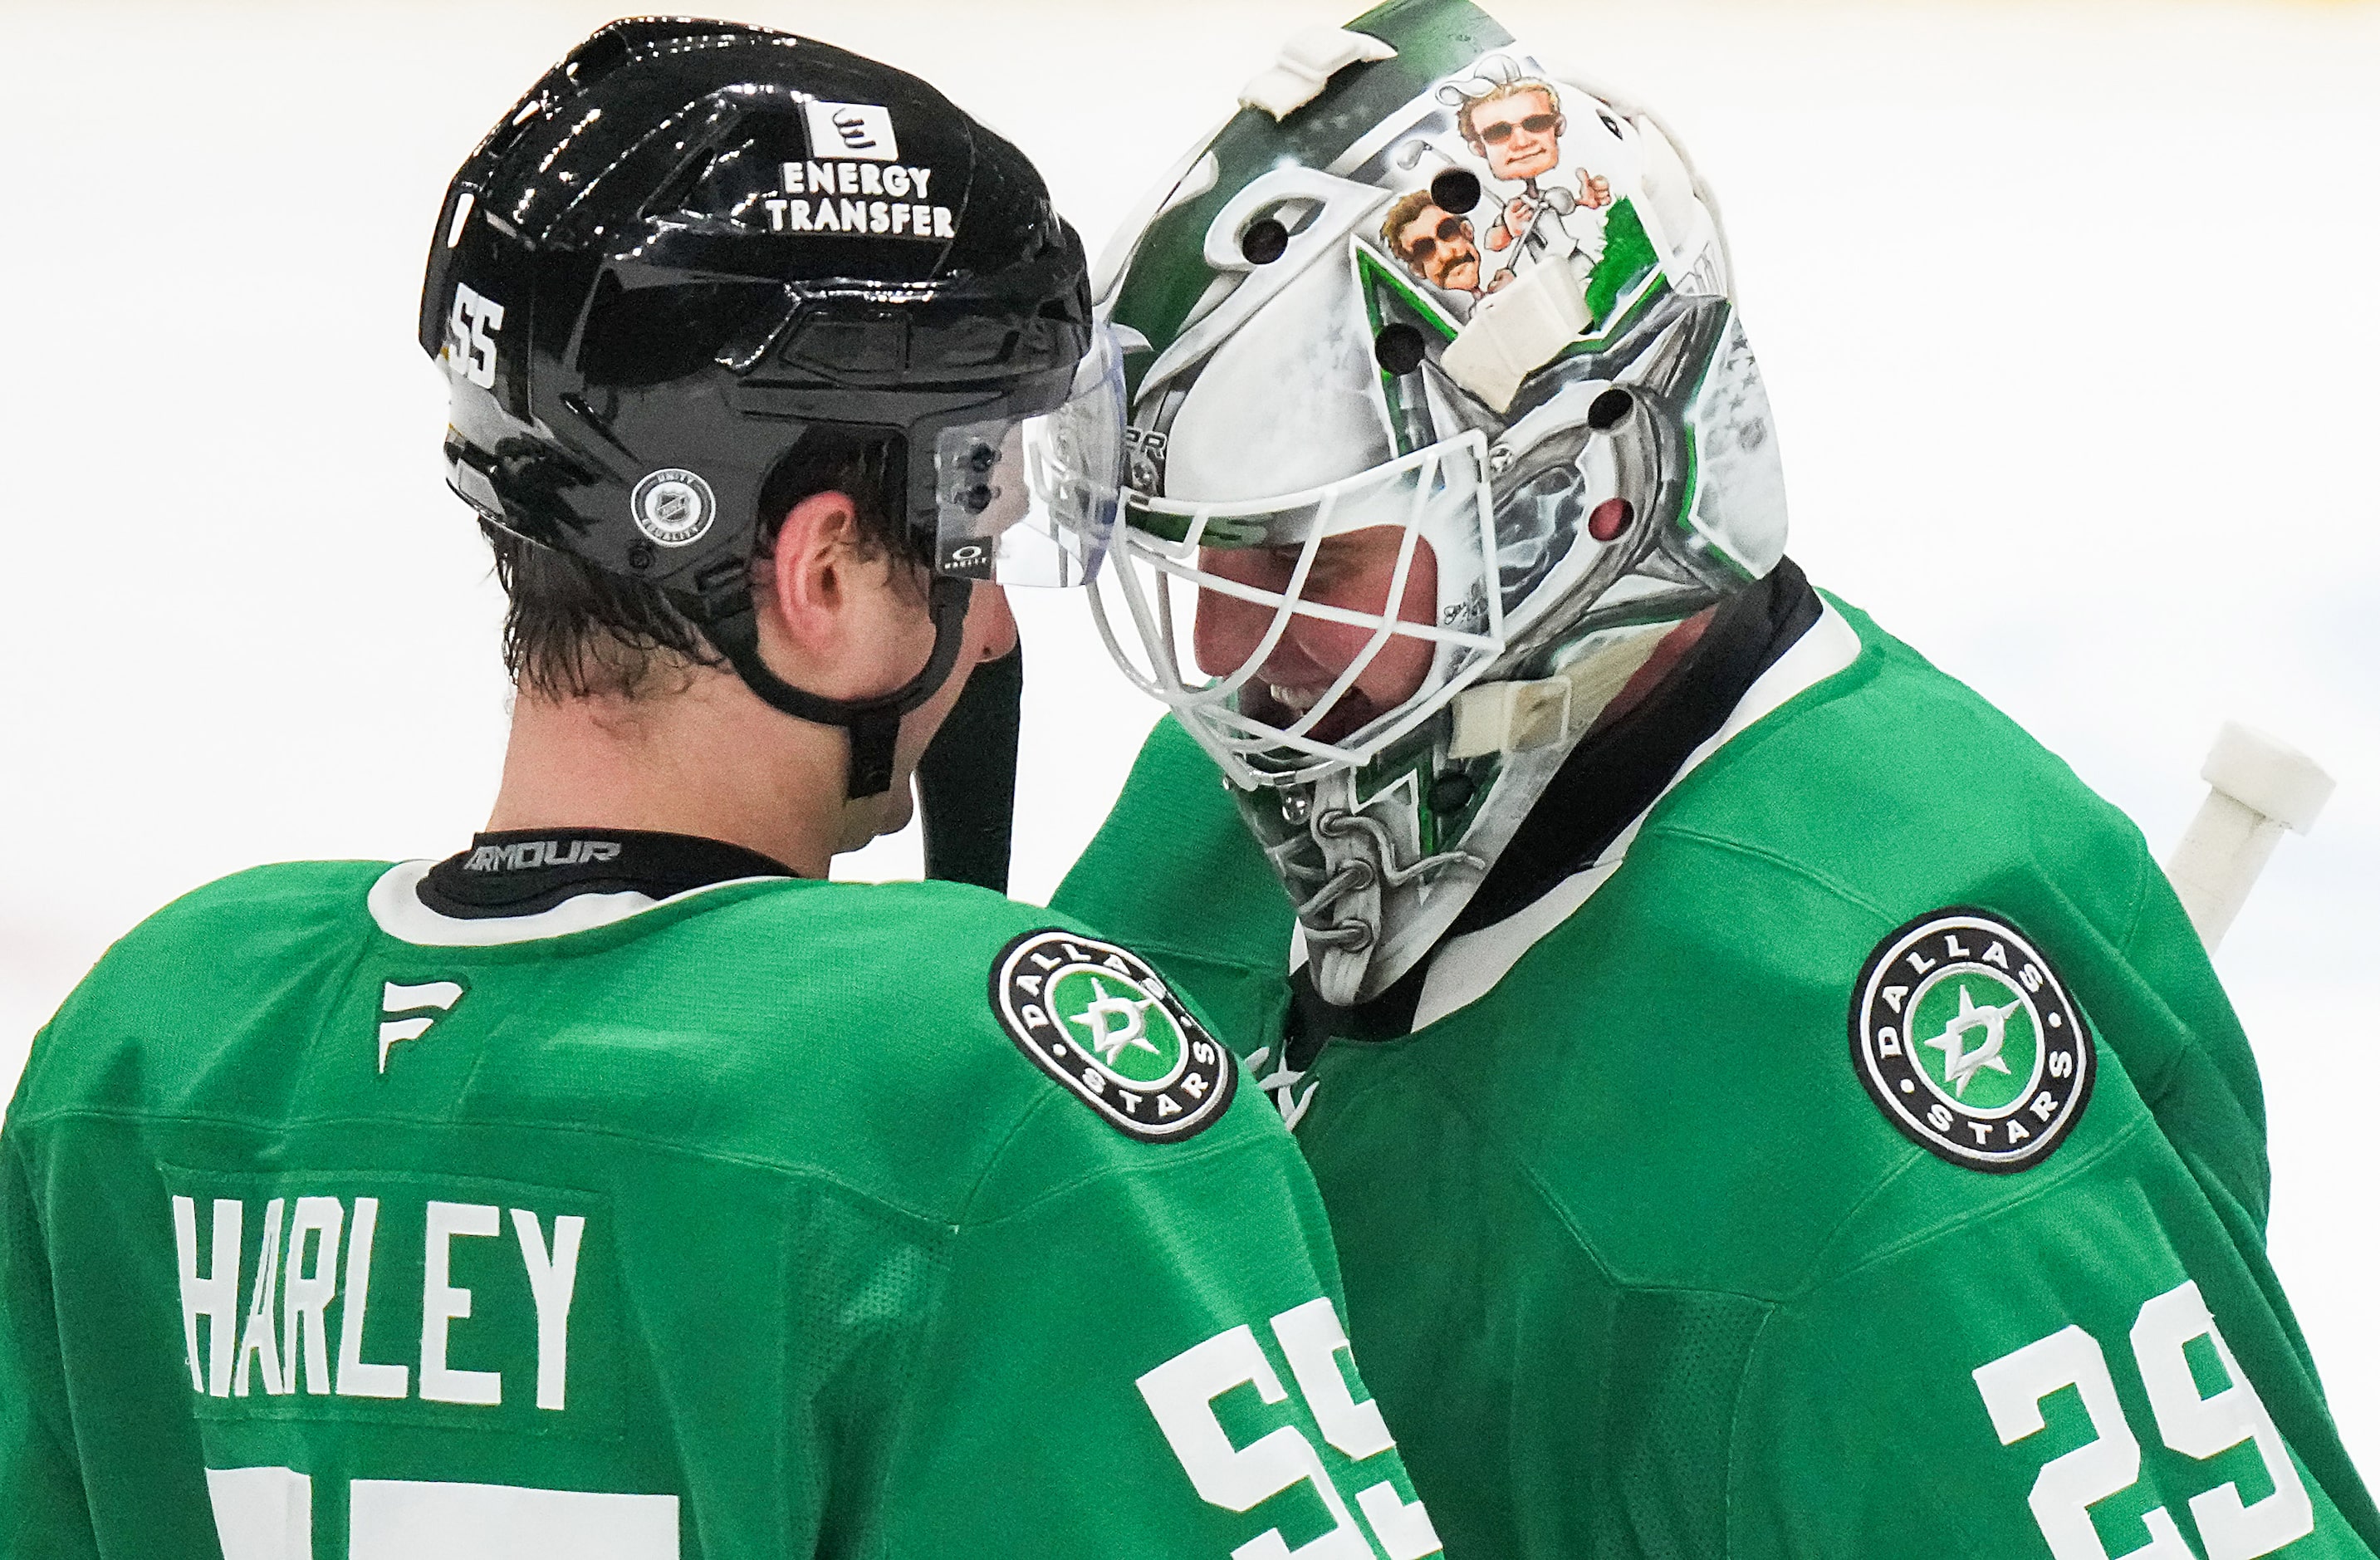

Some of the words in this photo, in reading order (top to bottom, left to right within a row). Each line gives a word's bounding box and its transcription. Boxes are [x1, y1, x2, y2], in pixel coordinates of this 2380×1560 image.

[765, 198, 956, 238] TRANSFER
[783, 160, 931, 199] ENERGY
[448, 282, 505, 389] 55
[463, 840, 621, 872] ARMOUR
[1016, 944, 1166, 1030] DALLAS
[1878, 935, 2043, 1059] DALLAS
[1082, 1041, 1216, 1116] STARS
[1927, 1051, 2073, 1145] STARS
[173, 1195, 585, 1410] HARLEY
[1135, 1297, 1444, 1560] 55
[1971, 1279, 2314, 1560] 29
